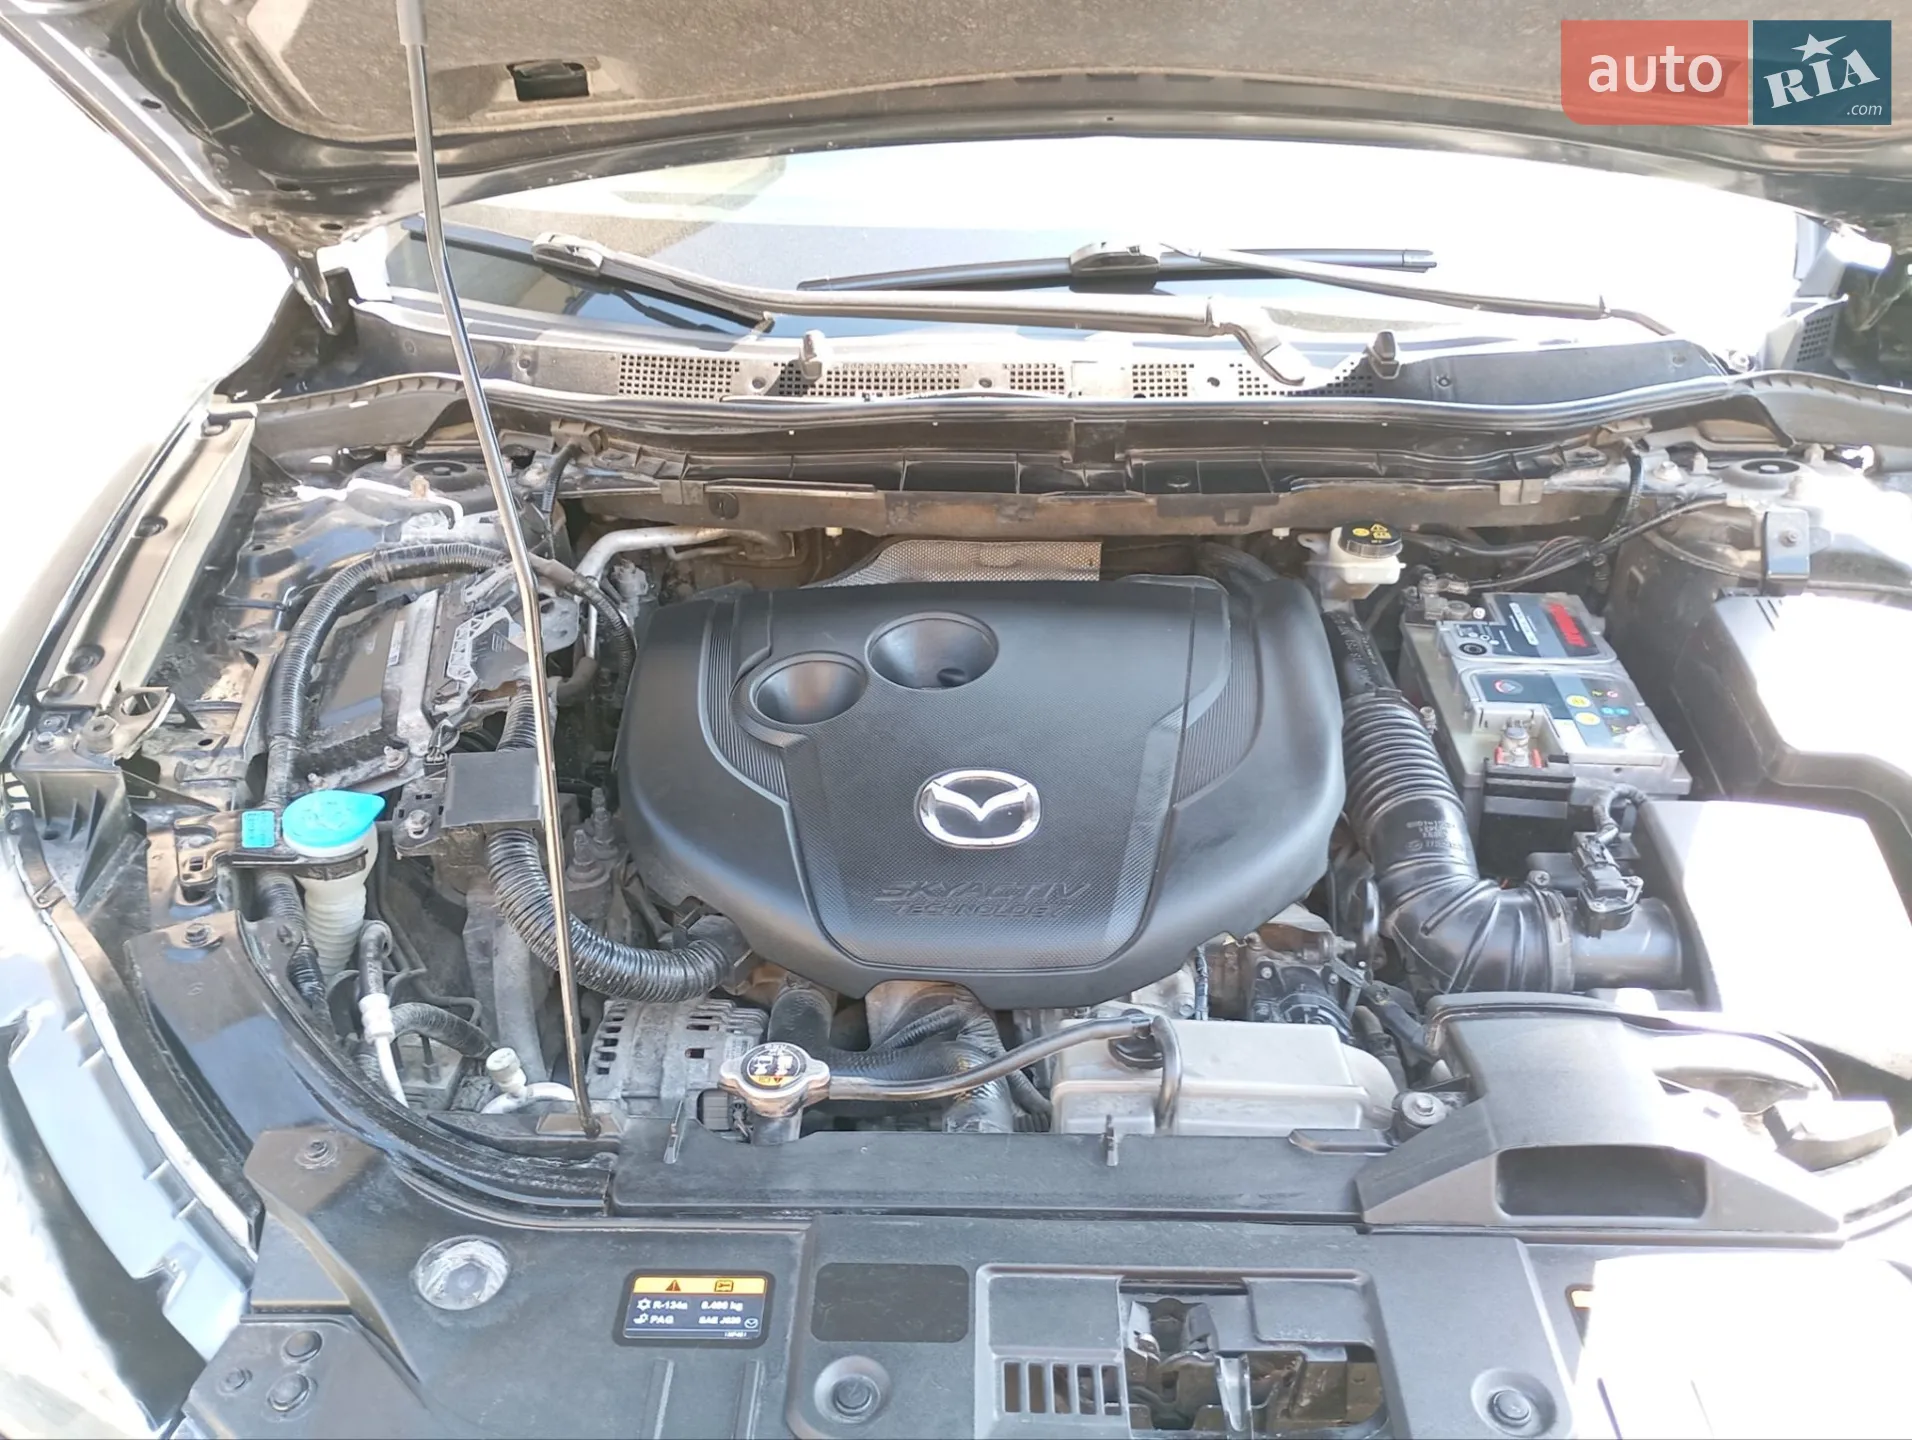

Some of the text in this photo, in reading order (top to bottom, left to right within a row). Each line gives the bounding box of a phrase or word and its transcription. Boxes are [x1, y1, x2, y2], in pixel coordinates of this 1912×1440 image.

[874, 880, 1091, 901] SKYACTIV
[894, 901, 1072, 918] TECHNOLOGY
[650, 1315, 674, 1324] PAG
